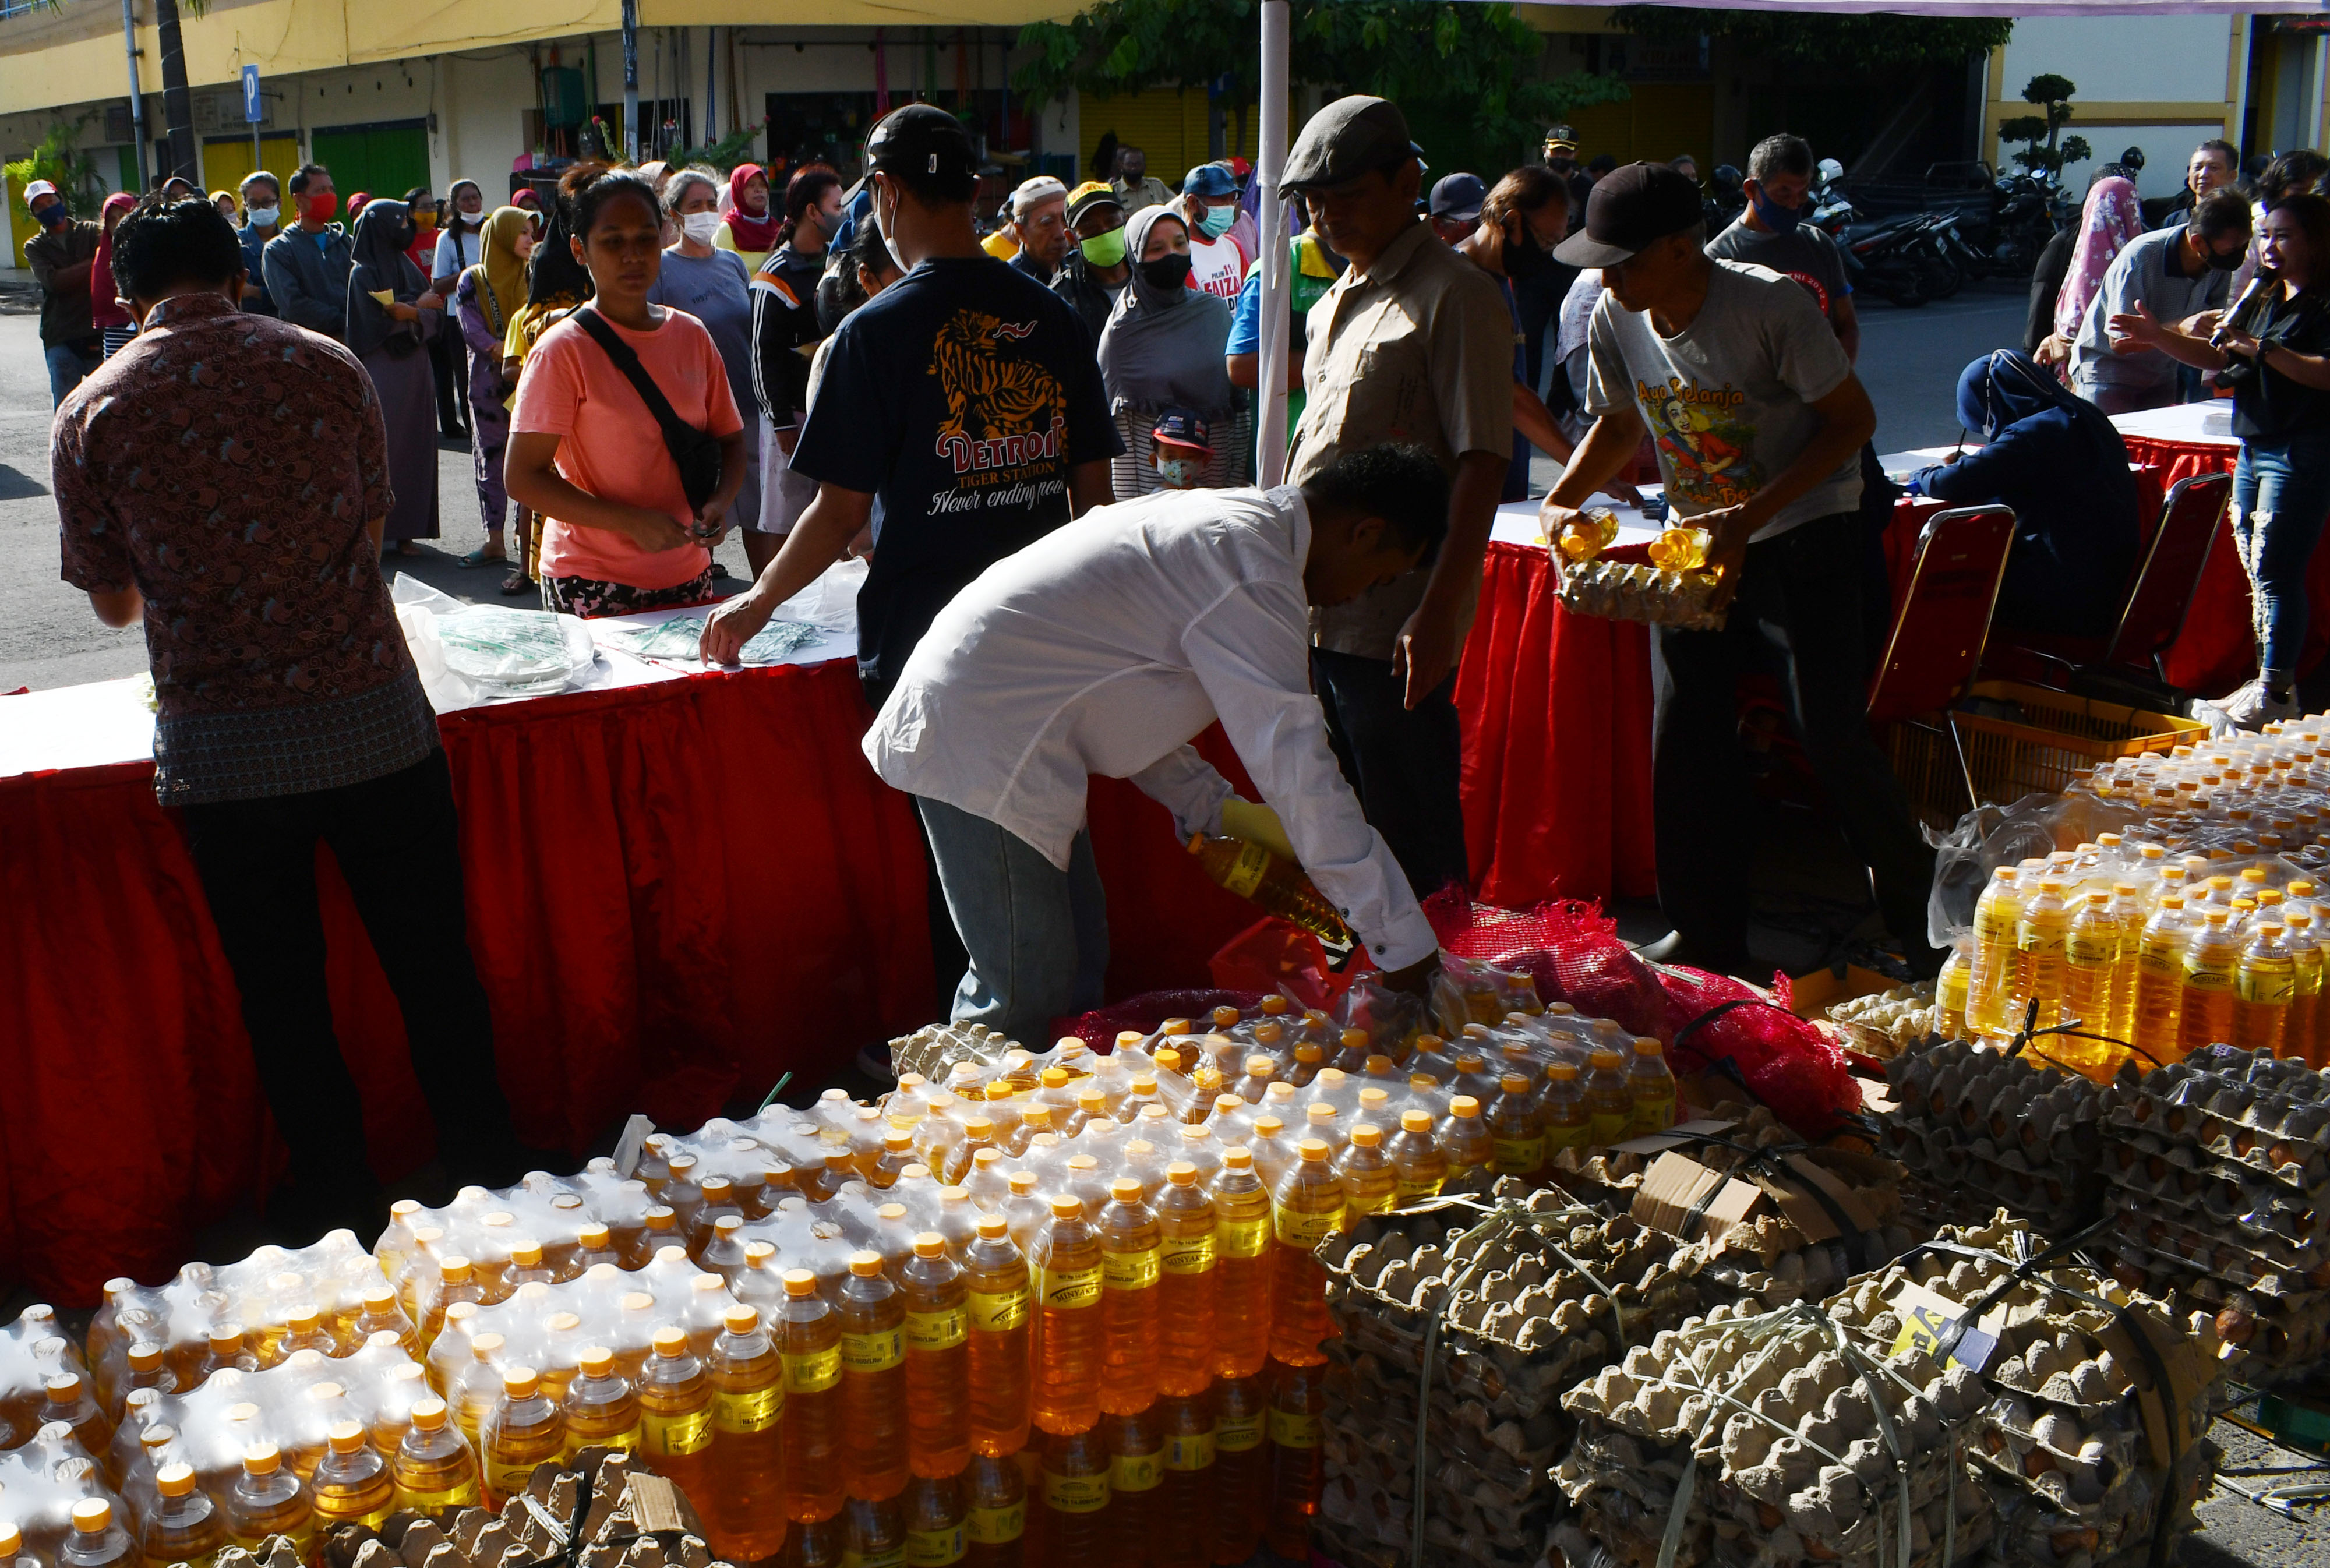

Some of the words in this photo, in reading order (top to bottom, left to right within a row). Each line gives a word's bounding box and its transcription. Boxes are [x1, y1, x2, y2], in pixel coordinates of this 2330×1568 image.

[246, 73, 255, 114] P
[1808, 278, 1826, 299] 2012
[1638, 380, 1667, 407] Ayo
[1669, 377, 1743, 410] Belanja
[936, 416, 1064, 473] DETROIT
[958, 472, 1000, 489] TIGER
[1002, 462, 1056, 483] STATION
[927, 487, 981, 516] Never
[987, 482, 1036, 511] ending
